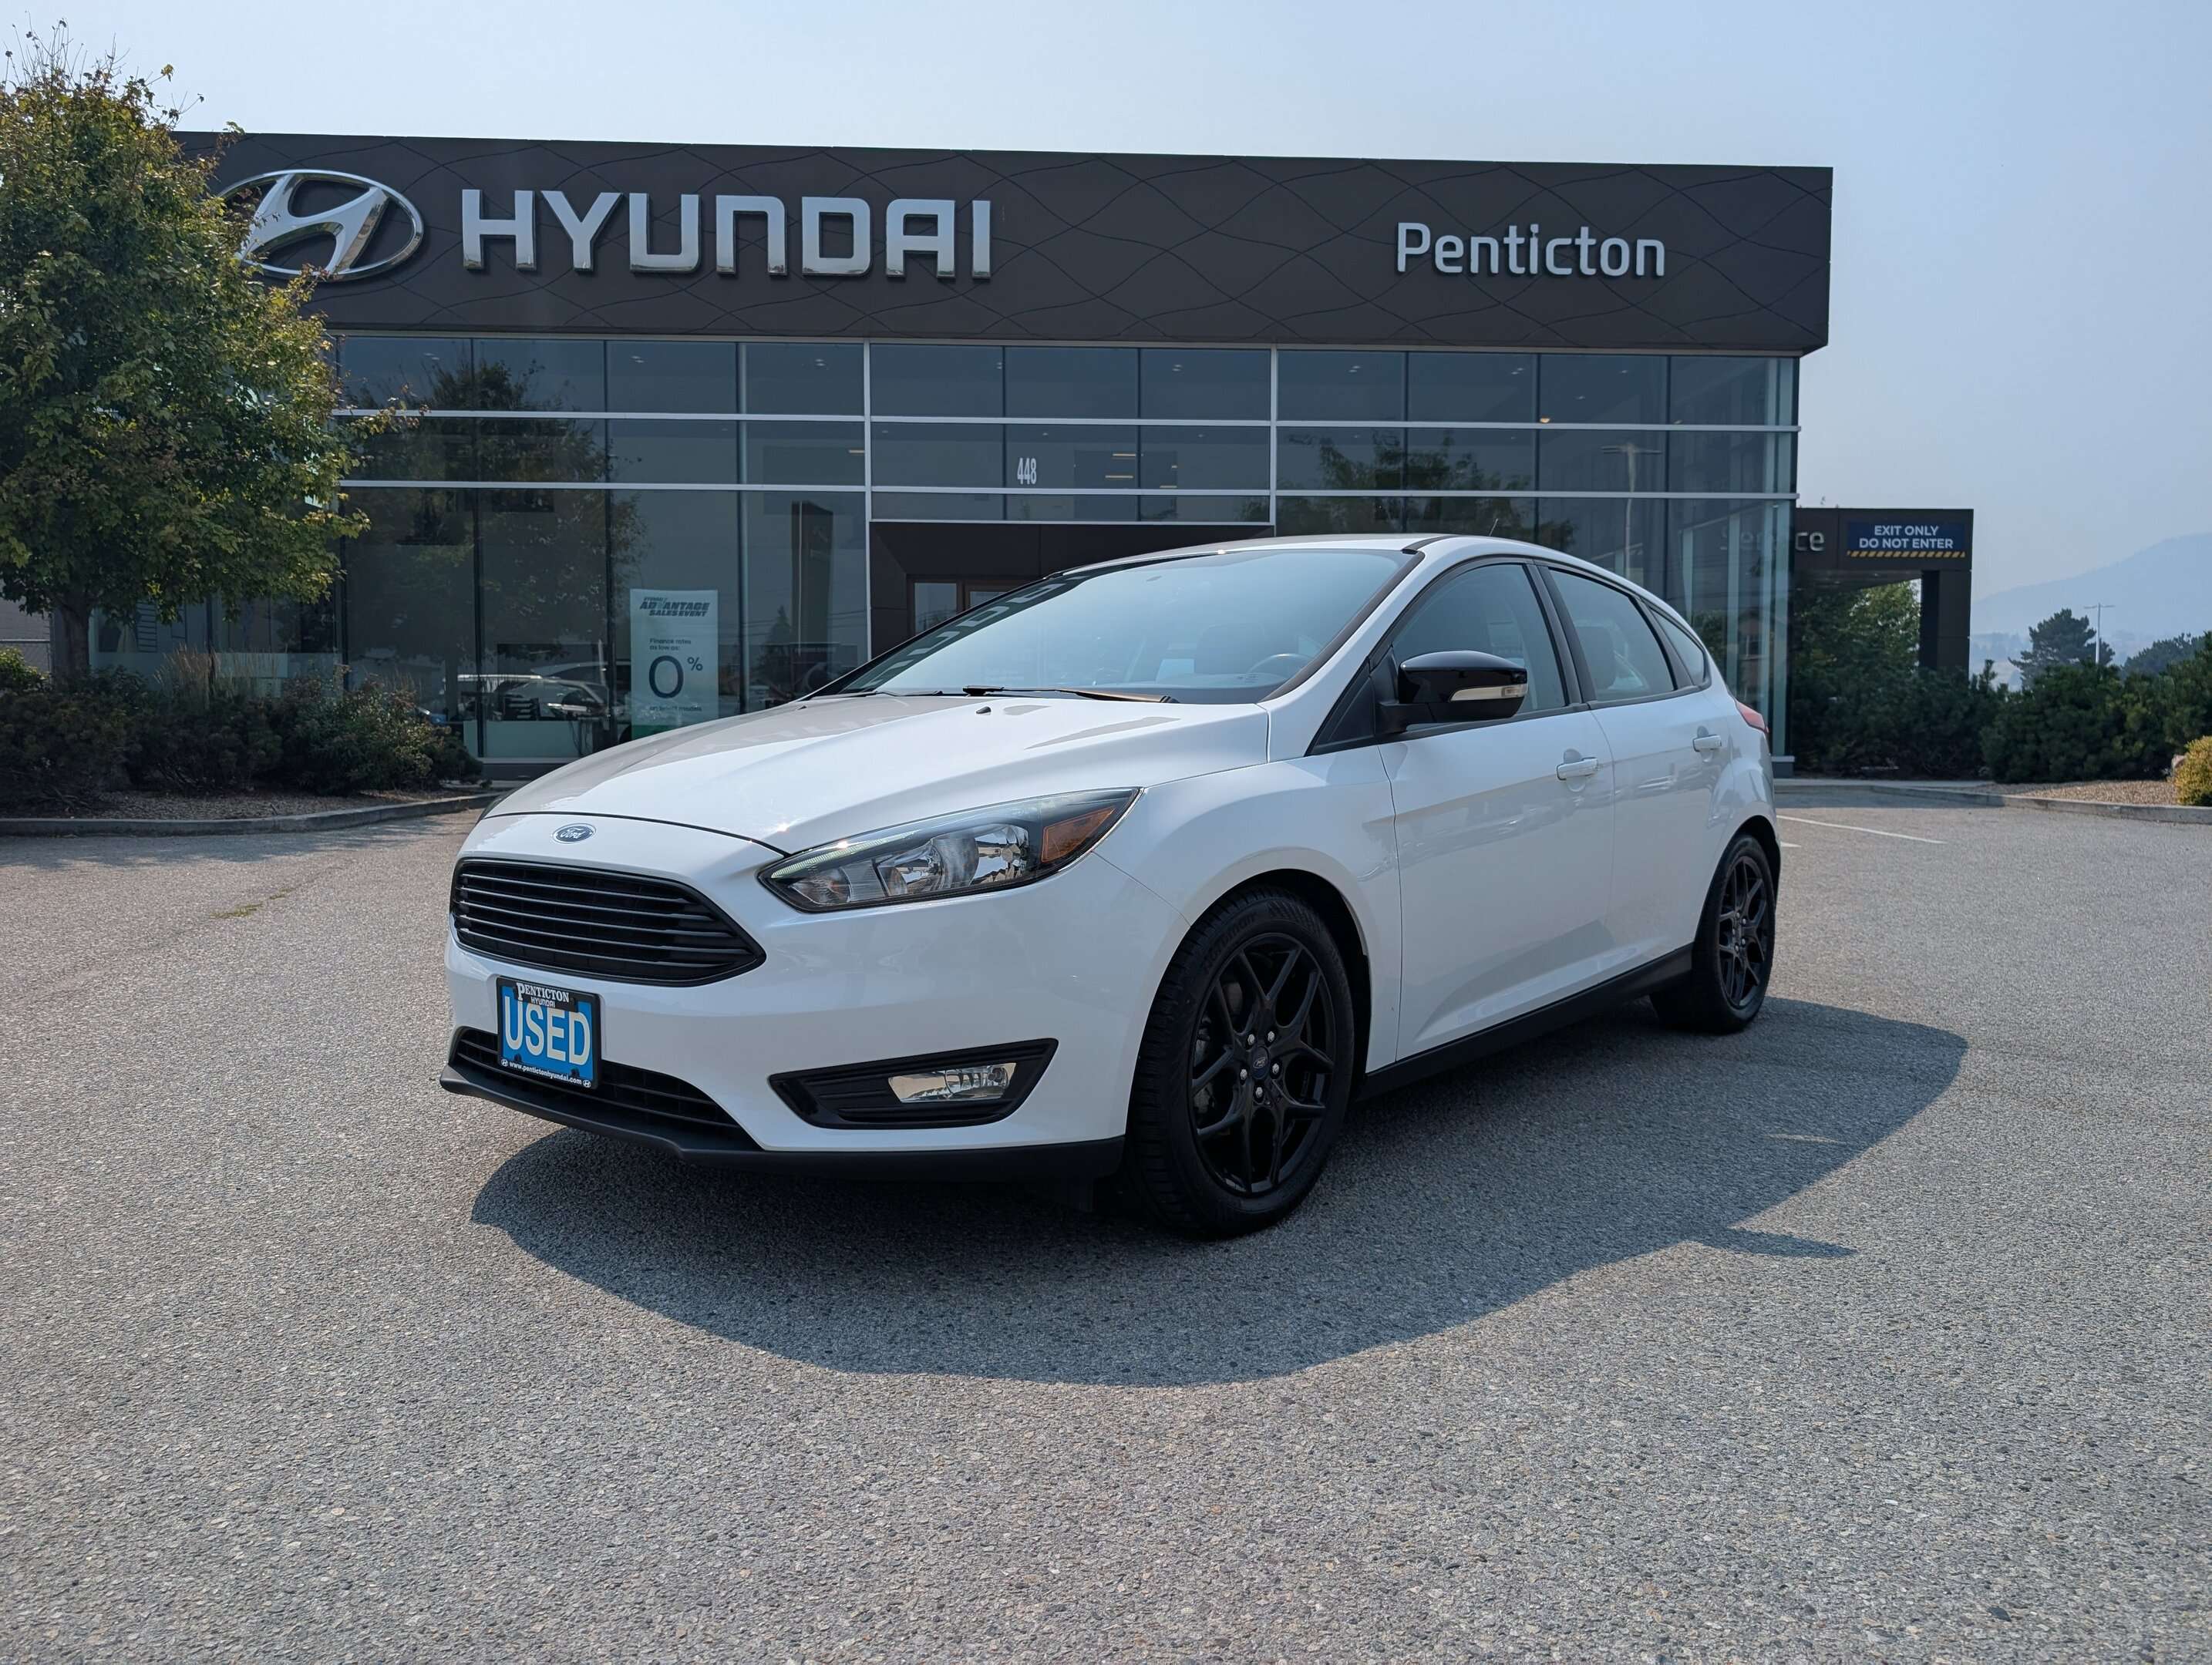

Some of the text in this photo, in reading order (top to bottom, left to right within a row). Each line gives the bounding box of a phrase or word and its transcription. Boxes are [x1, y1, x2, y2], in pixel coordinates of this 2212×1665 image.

[463, 189, 991, 279] HYUNDAI
[1396, 222, 1665, 277] Penticton
[1017, 457, 1037, 485] 448
[1874, 525, 1939, 536] EXIT ONLY
[1859, 538, 1953, 550] DO NOT ENTER
[516, 982, 570, 1003] PENTICTON
[530, 996, 556, 1008] HYUNDAI
[504, 995, 591, 1066] USED
